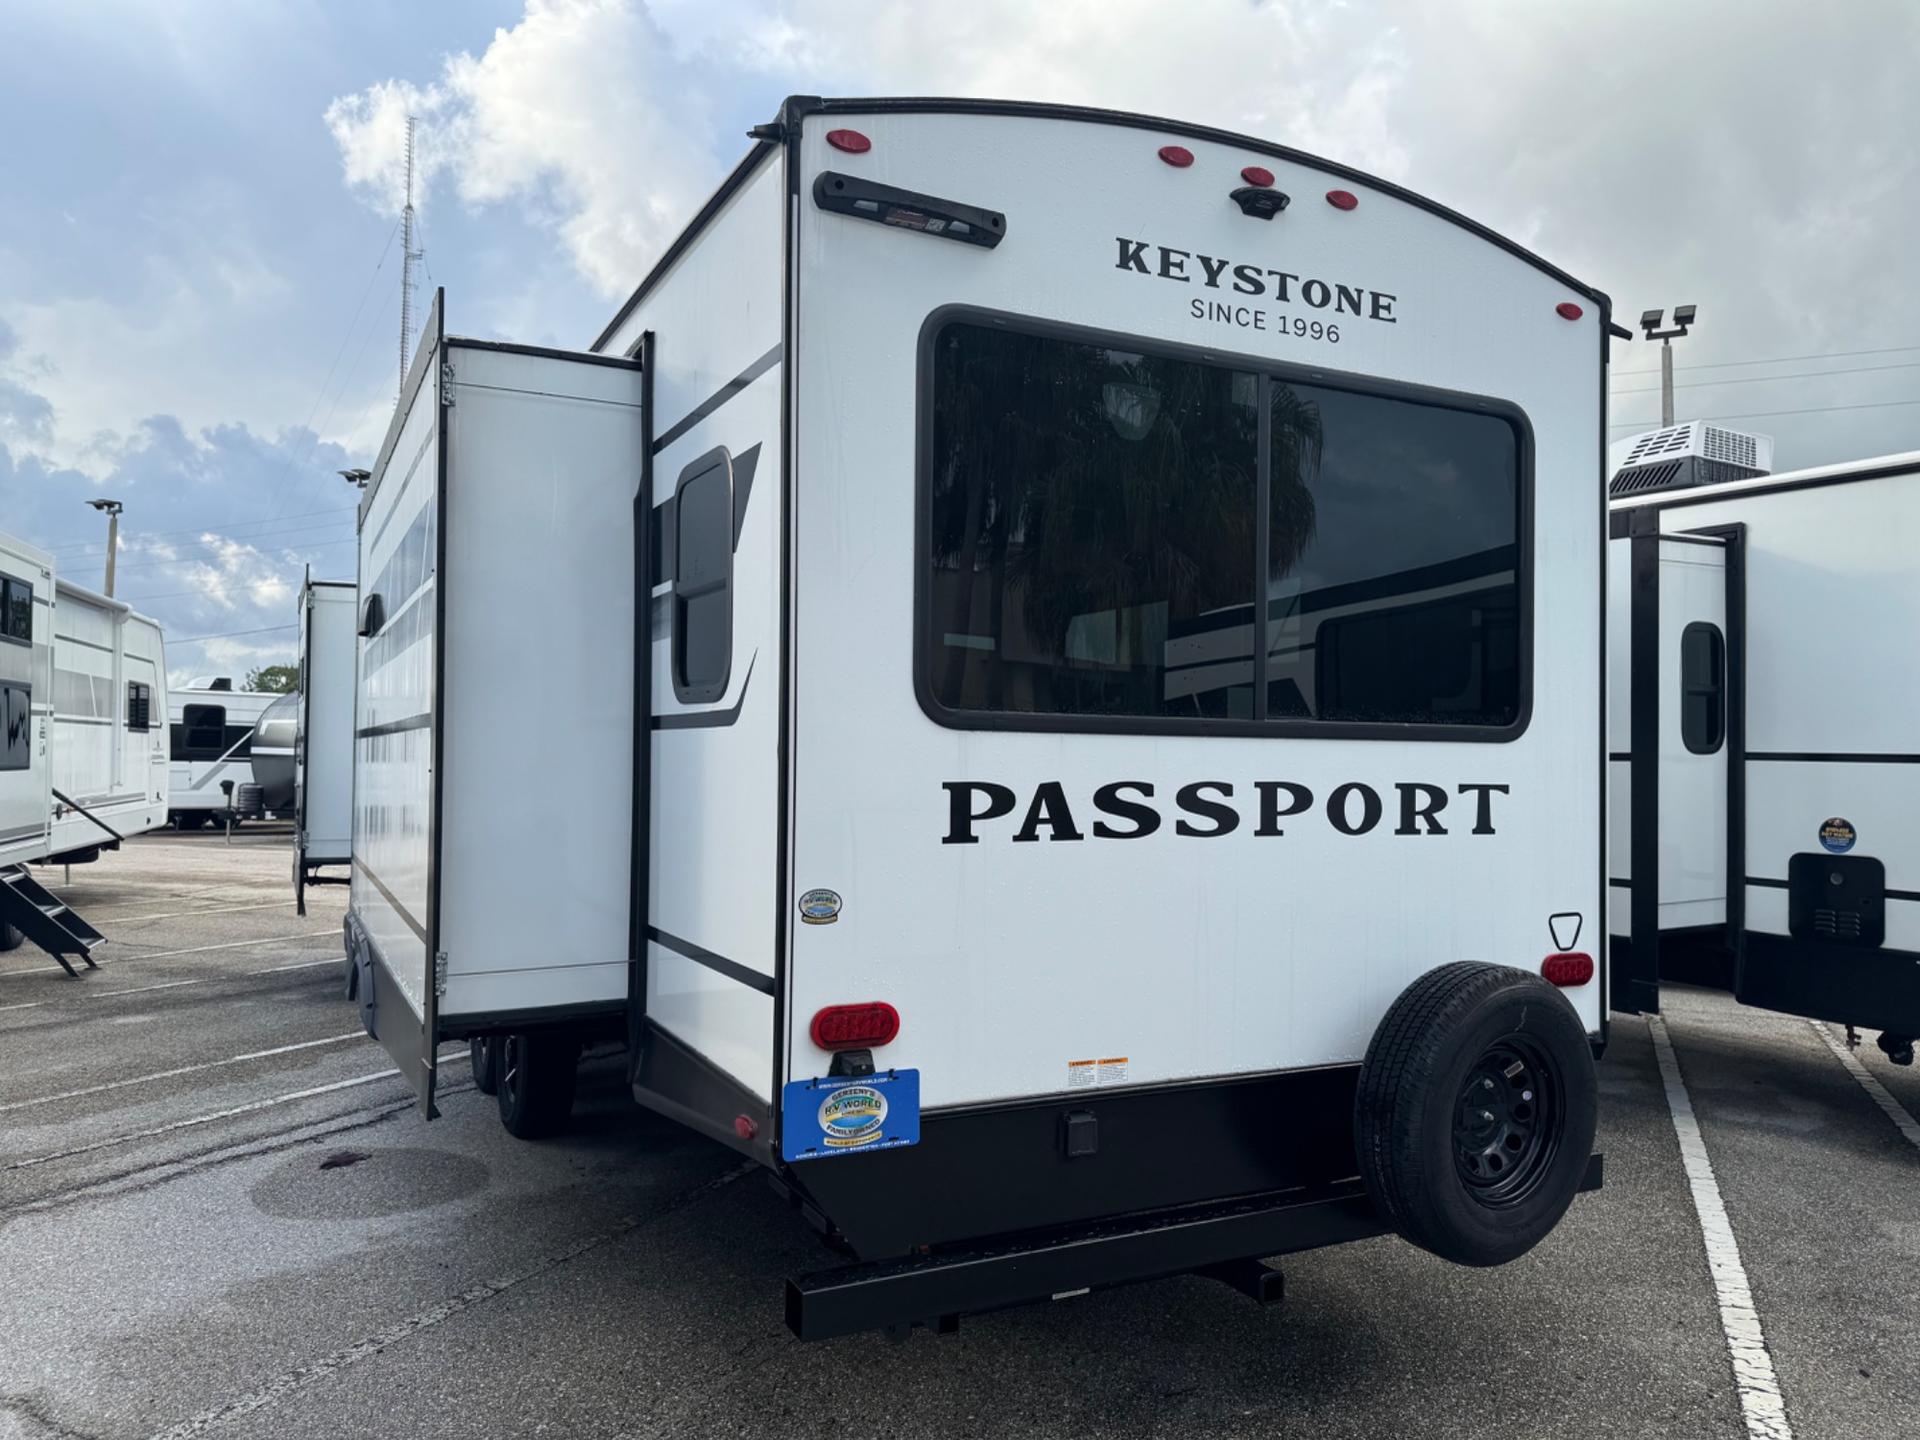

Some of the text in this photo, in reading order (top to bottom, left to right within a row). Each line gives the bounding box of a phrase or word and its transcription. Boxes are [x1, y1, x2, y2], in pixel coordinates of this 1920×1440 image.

[1115, 237, 1397, 323] KEYSTONE
[1190, 299, 1340, 343] SINCE 1996
[942, 781, 1510, 844] PASSPORT
[844, 1100, 882, 1109] WORLD
